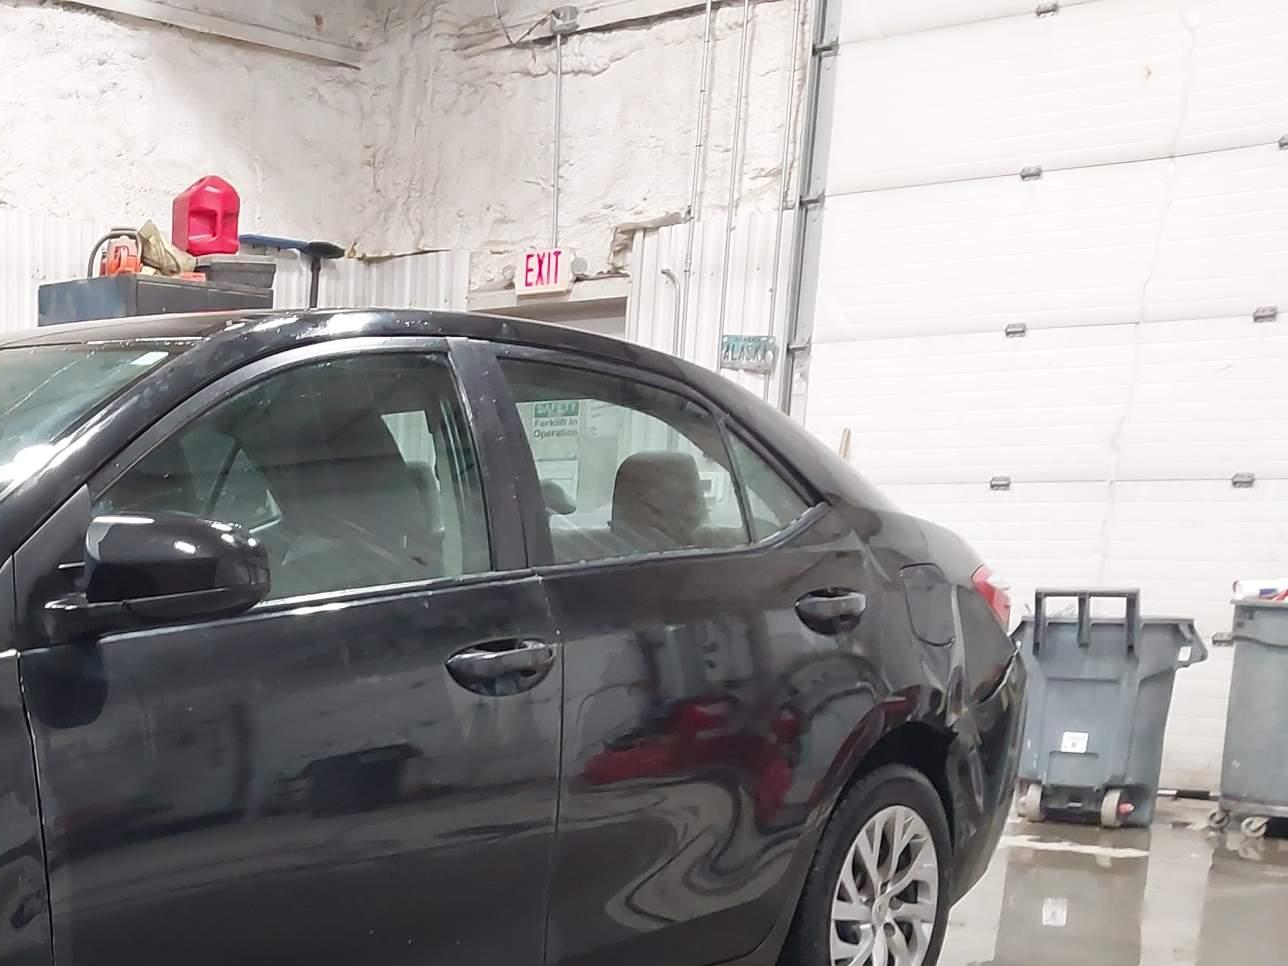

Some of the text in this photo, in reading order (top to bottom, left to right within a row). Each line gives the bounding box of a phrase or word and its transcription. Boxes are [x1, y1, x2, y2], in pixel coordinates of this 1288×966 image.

[525, 250, 562, 287] EXIT
[534, 418, 567, 427] Forklift
[533, 429, 578, 440] Operation
